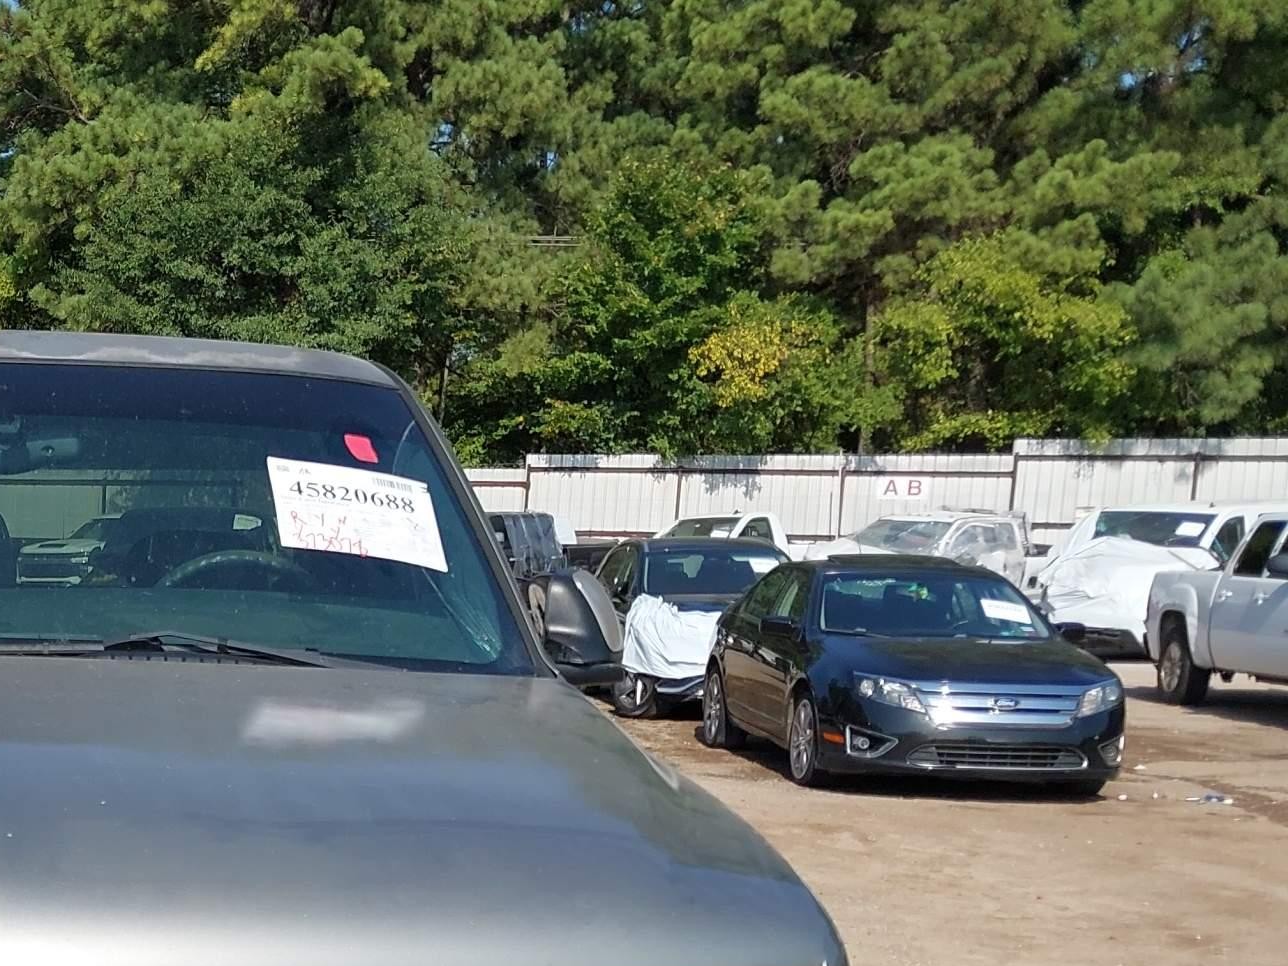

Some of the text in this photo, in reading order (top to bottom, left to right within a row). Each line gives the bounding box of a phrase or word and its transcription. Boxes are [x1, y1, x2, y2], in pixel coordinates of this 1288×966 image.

[289, 480, 415, 513] 45820688
[883, 479, 923, 496] A B
